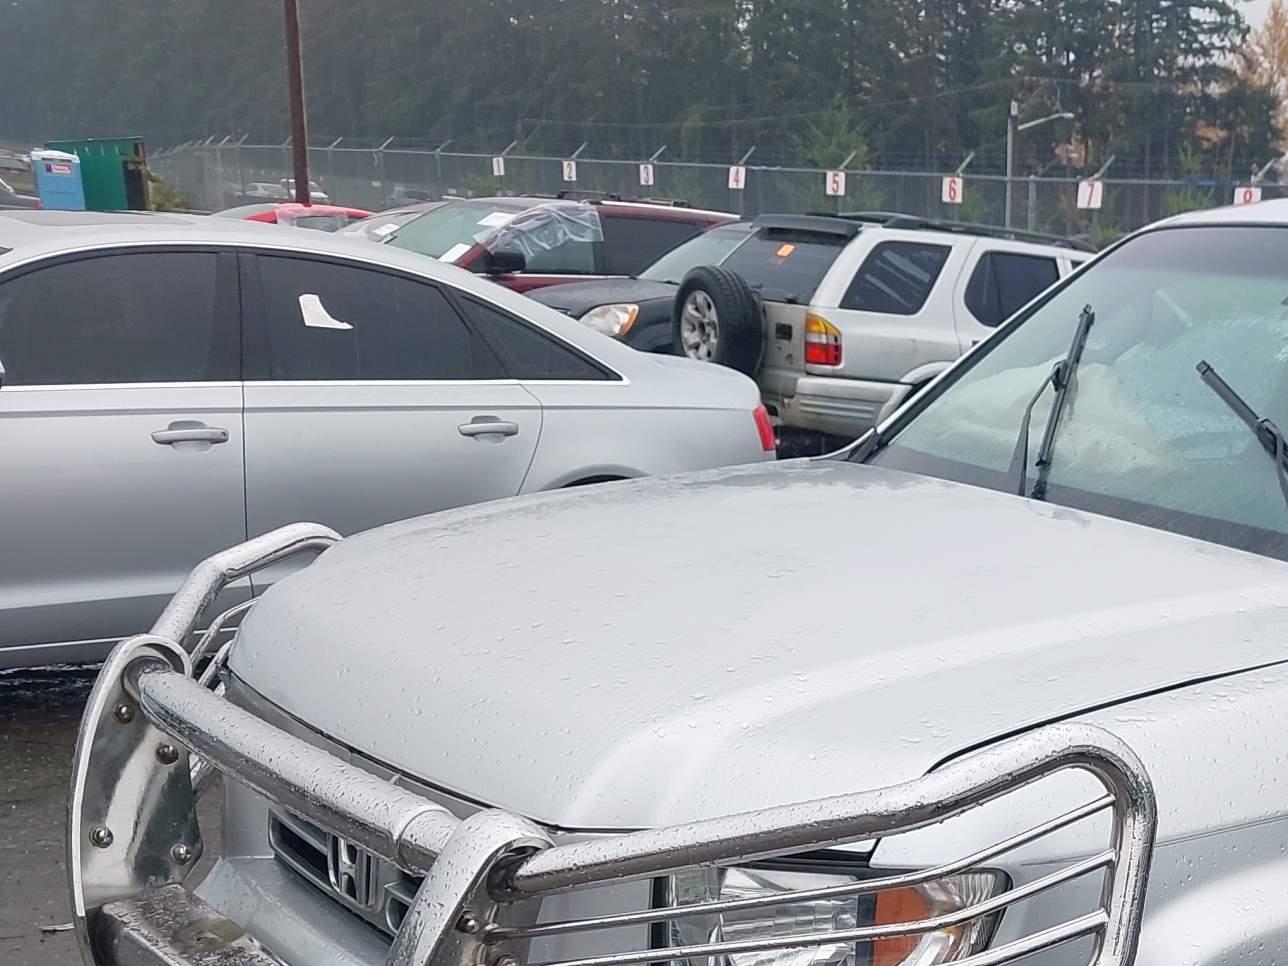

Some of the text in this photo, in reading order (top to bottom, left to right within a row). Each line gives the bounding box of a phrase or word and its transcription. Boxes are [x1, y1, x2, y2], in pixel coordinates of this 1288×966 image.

[495, 158, 502, 175] 1
[565, 161, 574, 179] 2
[643, 165, 651, 184] 3
[733, 167, 740, 188] 4
[831, 172, 840, 194] 5
[948, 178, 957, 201] 6
[1087, 183, 1095, 208] 7
